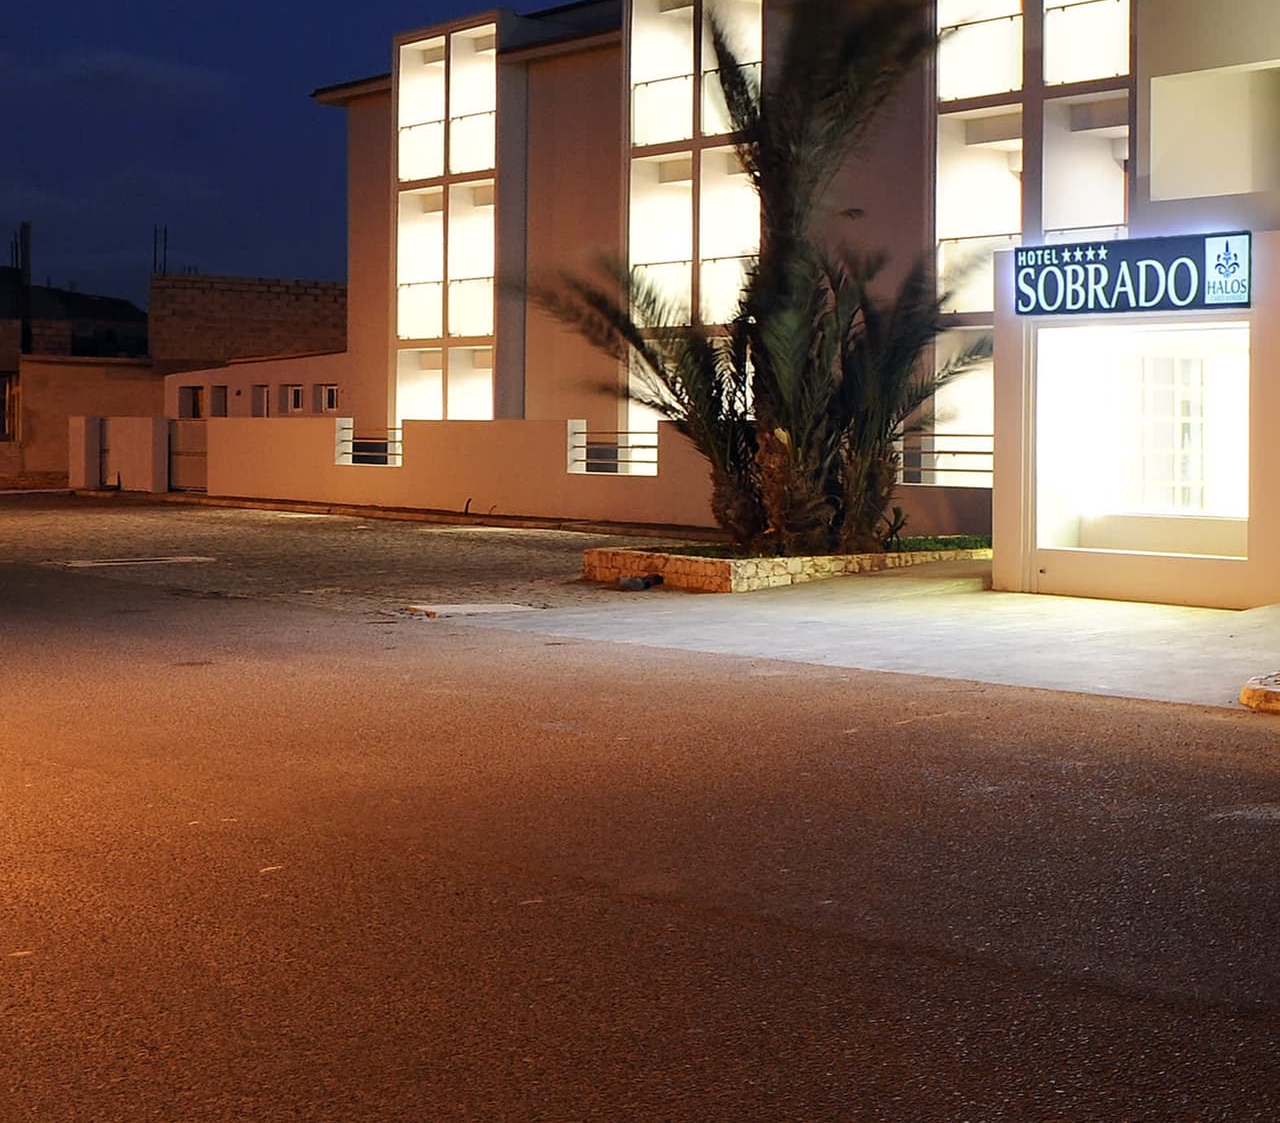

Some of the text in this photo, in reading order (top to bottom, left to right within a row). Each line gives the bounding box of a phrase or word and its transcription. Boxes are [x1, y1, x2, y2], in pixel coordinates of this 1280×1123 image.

[1018, 249, 1059, 266] HOTEL
[1018, 257, 1199, 312] SOBRADO
[1207, 278, 1247, 295] HALOS
